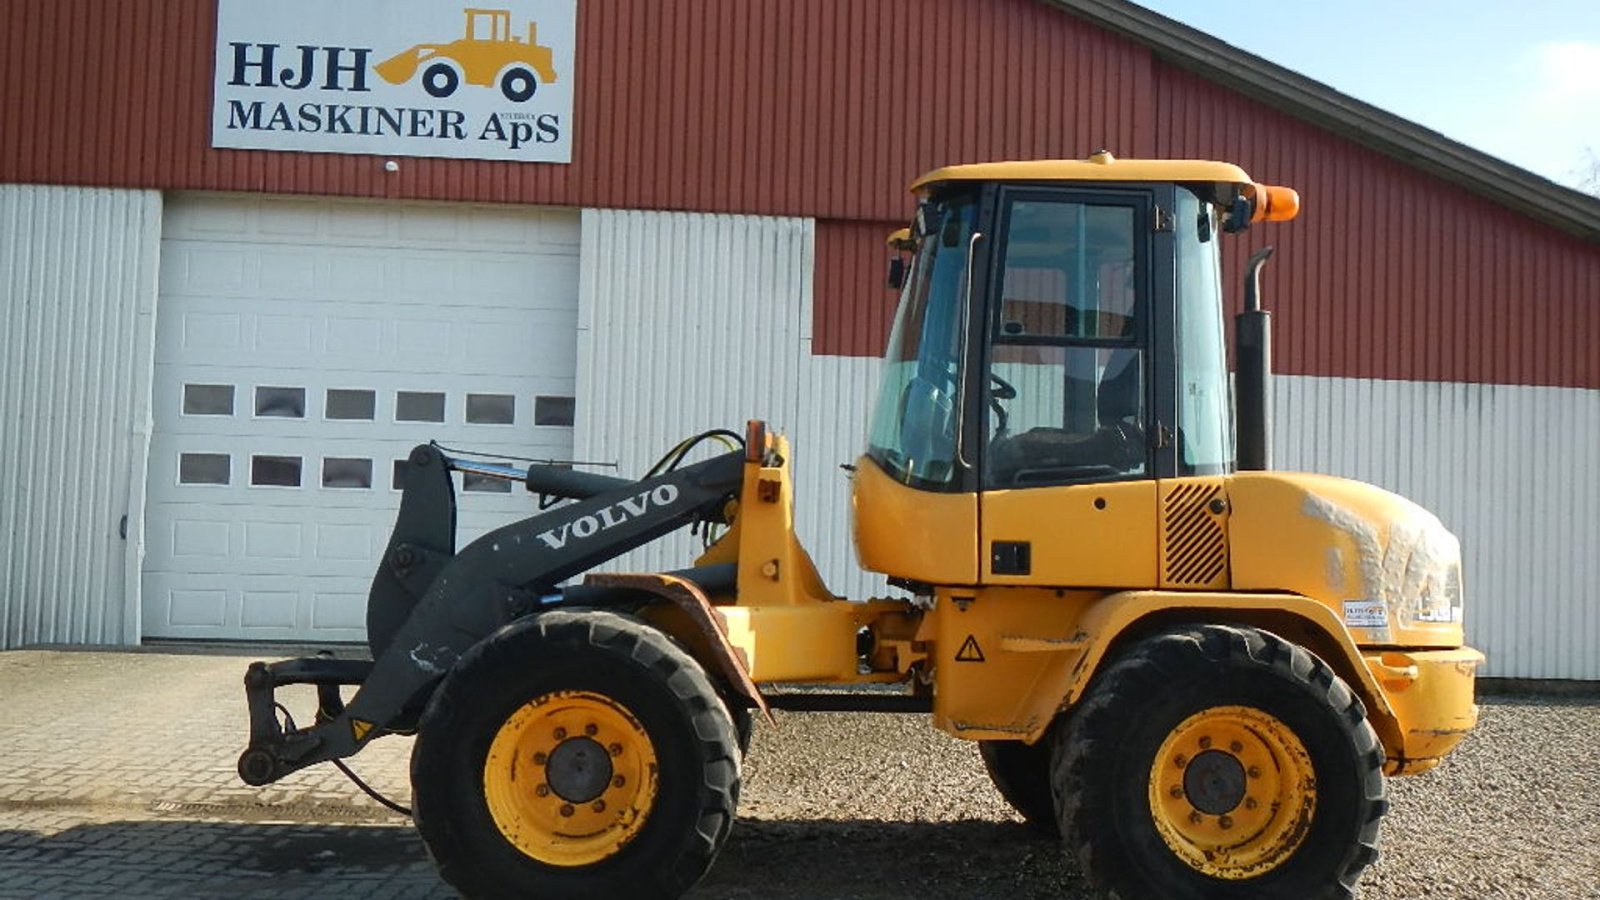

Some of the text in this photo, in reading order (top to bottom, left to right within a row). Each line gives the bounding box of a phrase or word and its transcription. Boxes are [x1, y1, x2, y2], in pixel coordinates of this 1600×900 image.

[228, 42, 372, 92] HJH
[228, 100, 559, 149] MASKINER ApS
[536, 484, 679, 550] VOLVO
